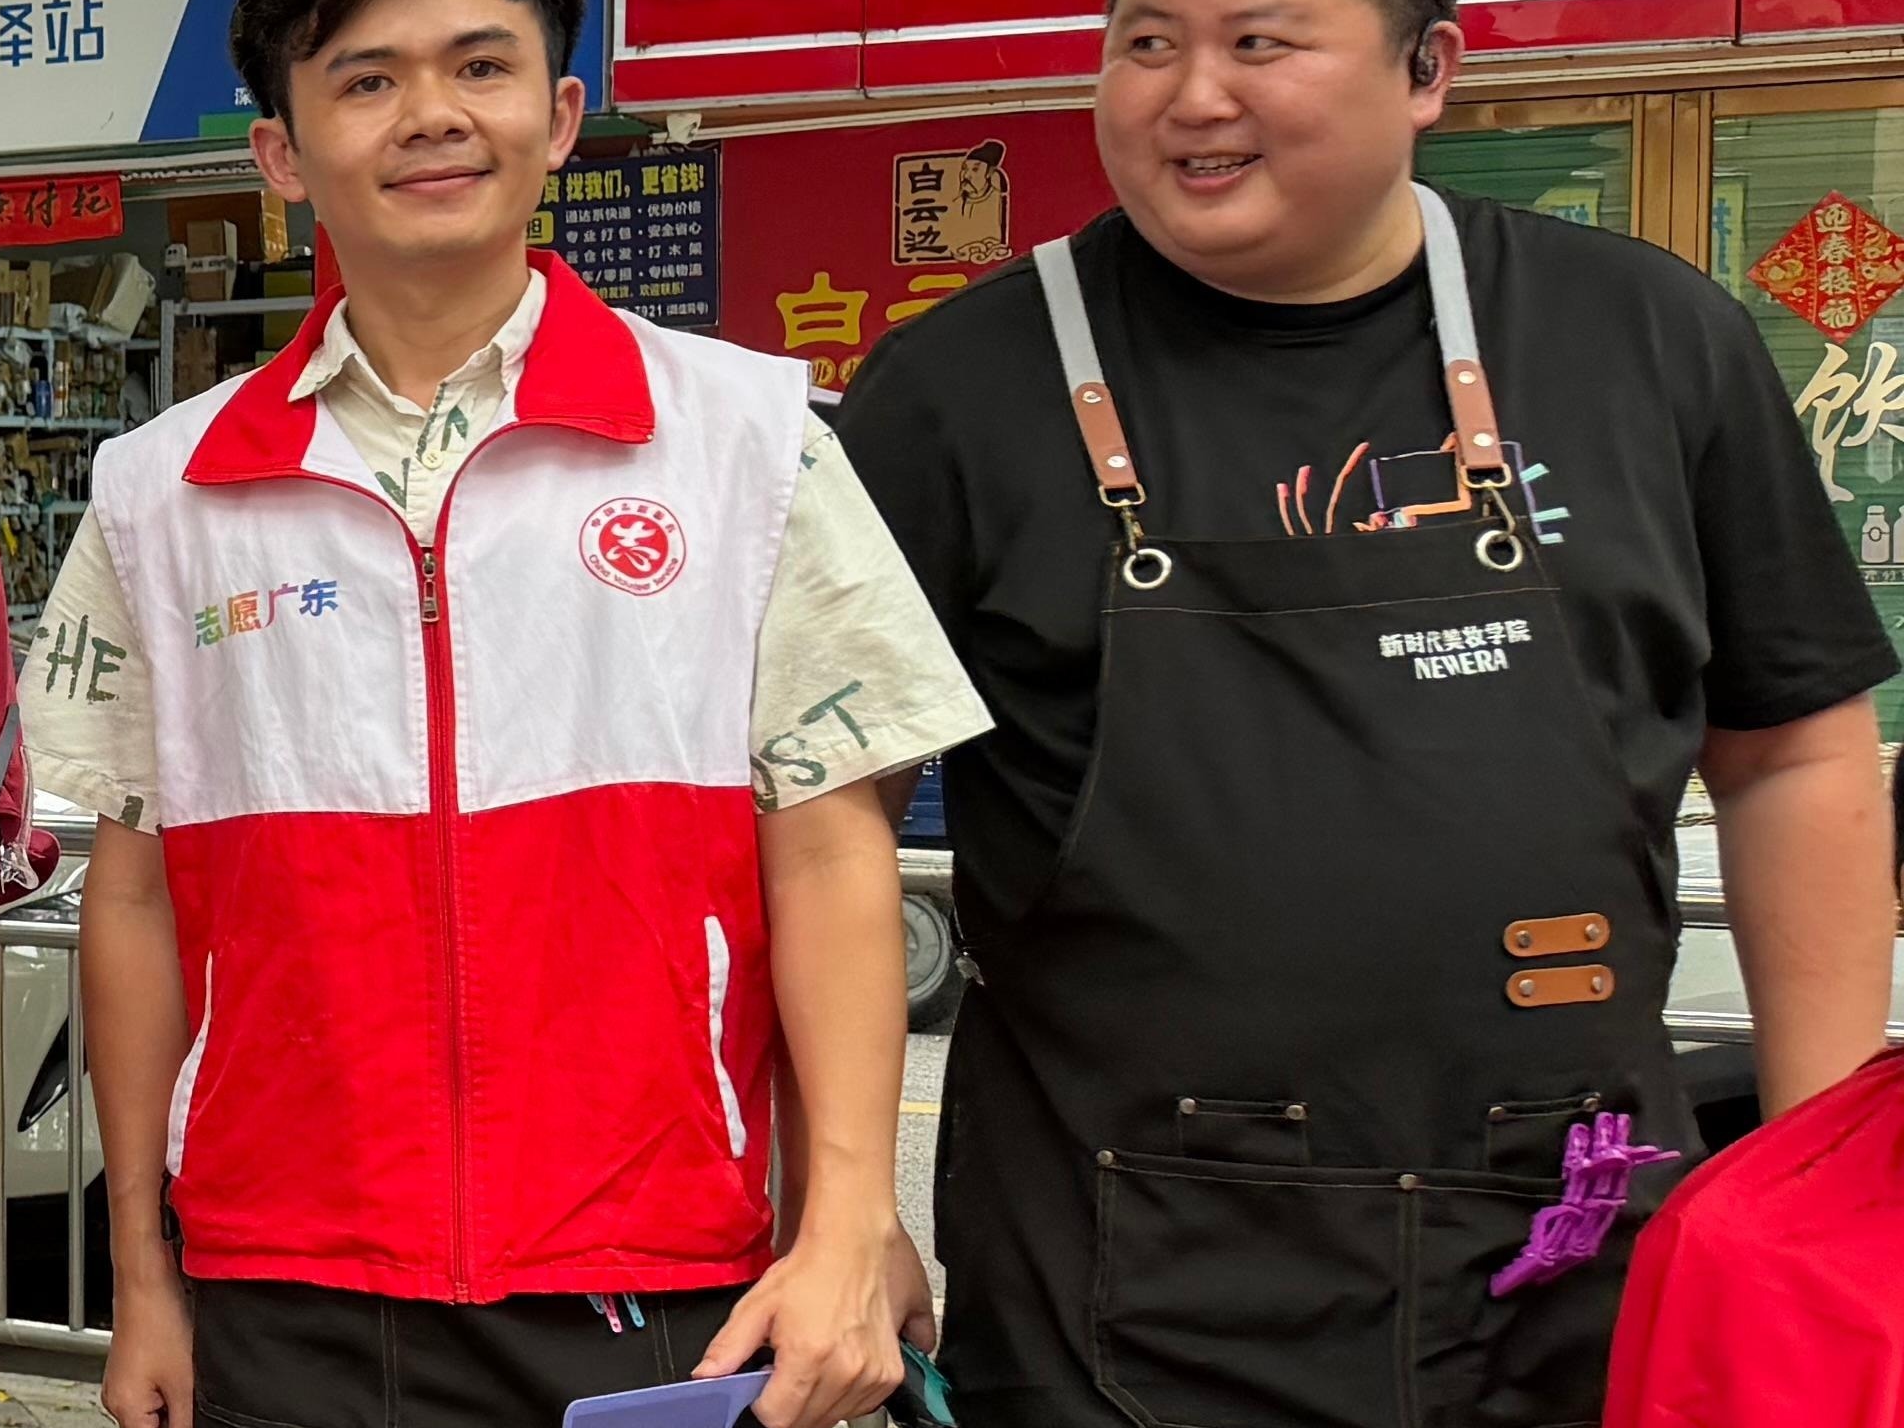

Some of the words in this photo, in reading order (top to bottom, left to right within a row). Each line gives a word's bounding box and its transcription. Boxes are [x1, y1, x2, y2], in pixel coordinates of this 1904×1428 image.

[903, 162, 948, 255] 白云边
[194, 578, 339, 649] 志愿广东
[1379, 619, 1533, 659] 新时代美妆学院
[35, 614, 127, 705] HE
